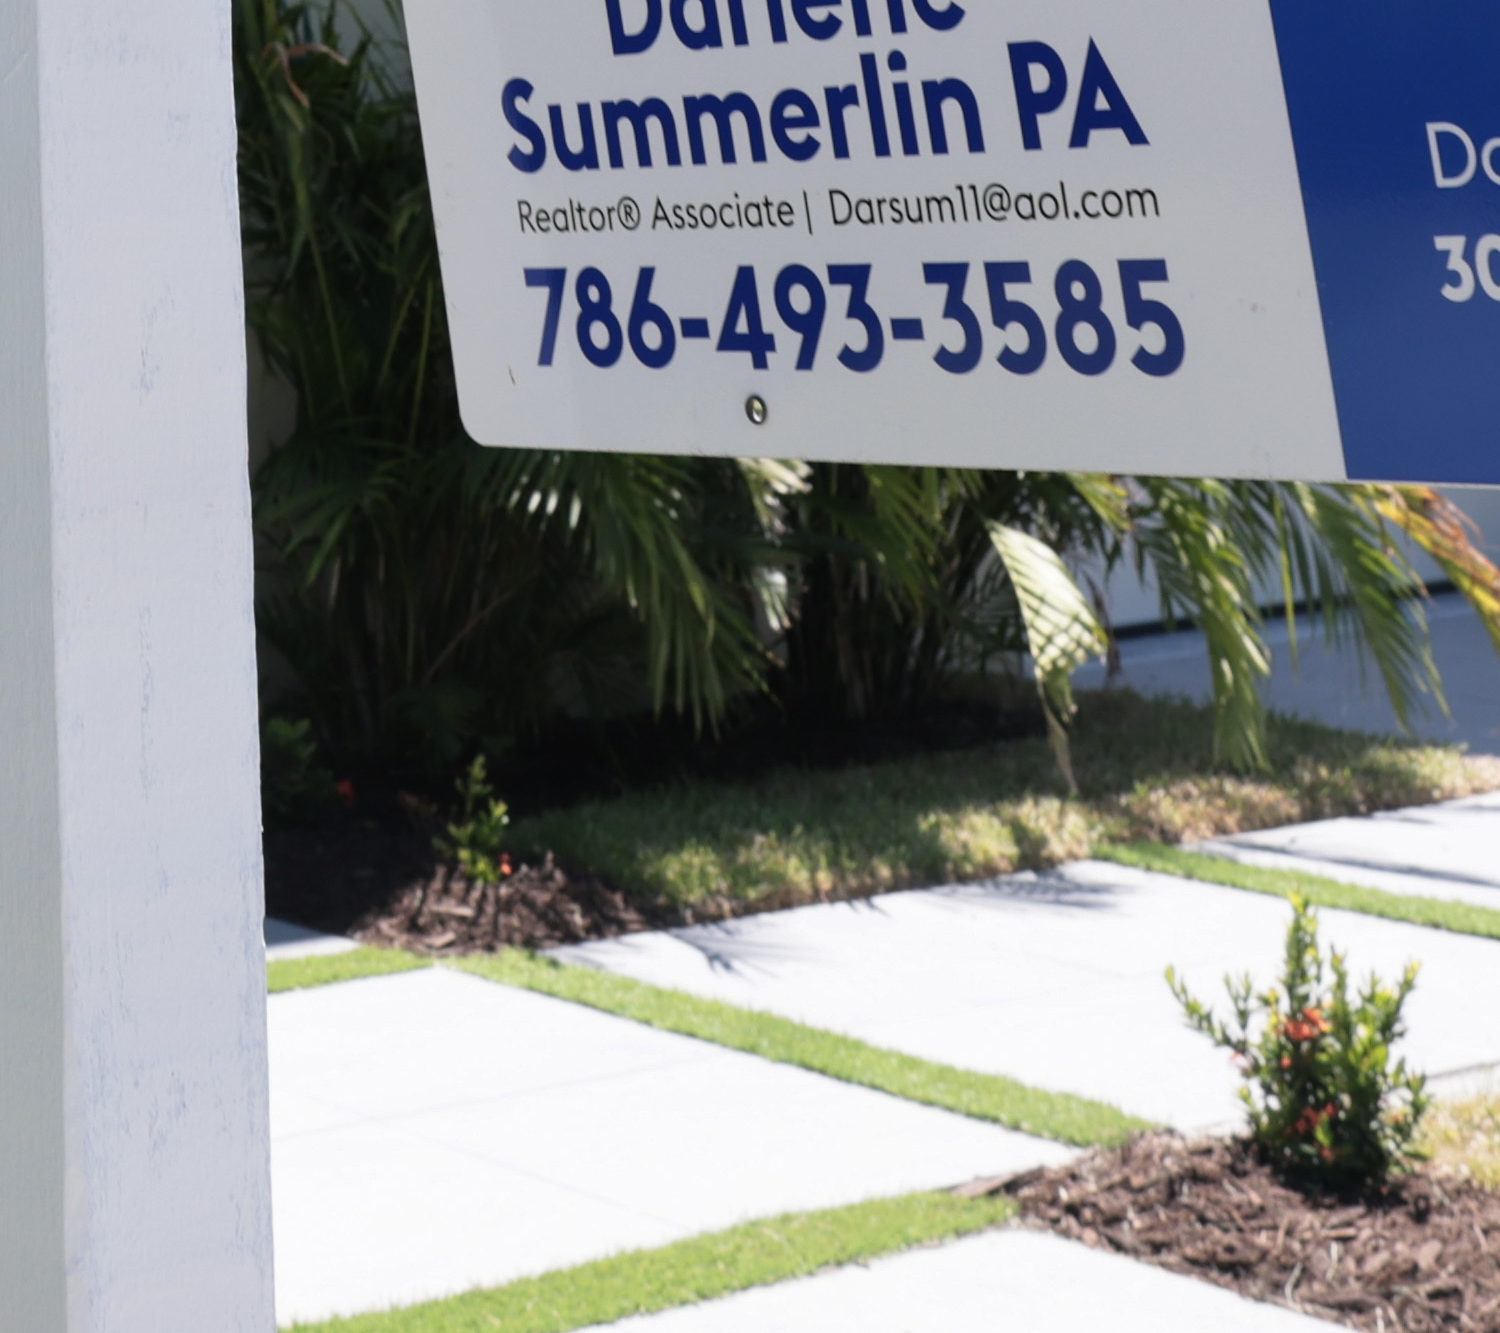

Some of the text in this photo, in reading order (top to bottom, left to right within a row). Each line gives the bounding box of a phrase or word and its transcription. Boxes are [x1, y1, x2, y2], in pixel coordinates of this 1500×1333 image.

[501, 35, 1151, 174] Summerlin PA
[651, 193, 795, 230] Associate
[828, 180, 1161, 227] Darsum11@aol.com
[523, 258, 1186, 377] 786-493-3585
